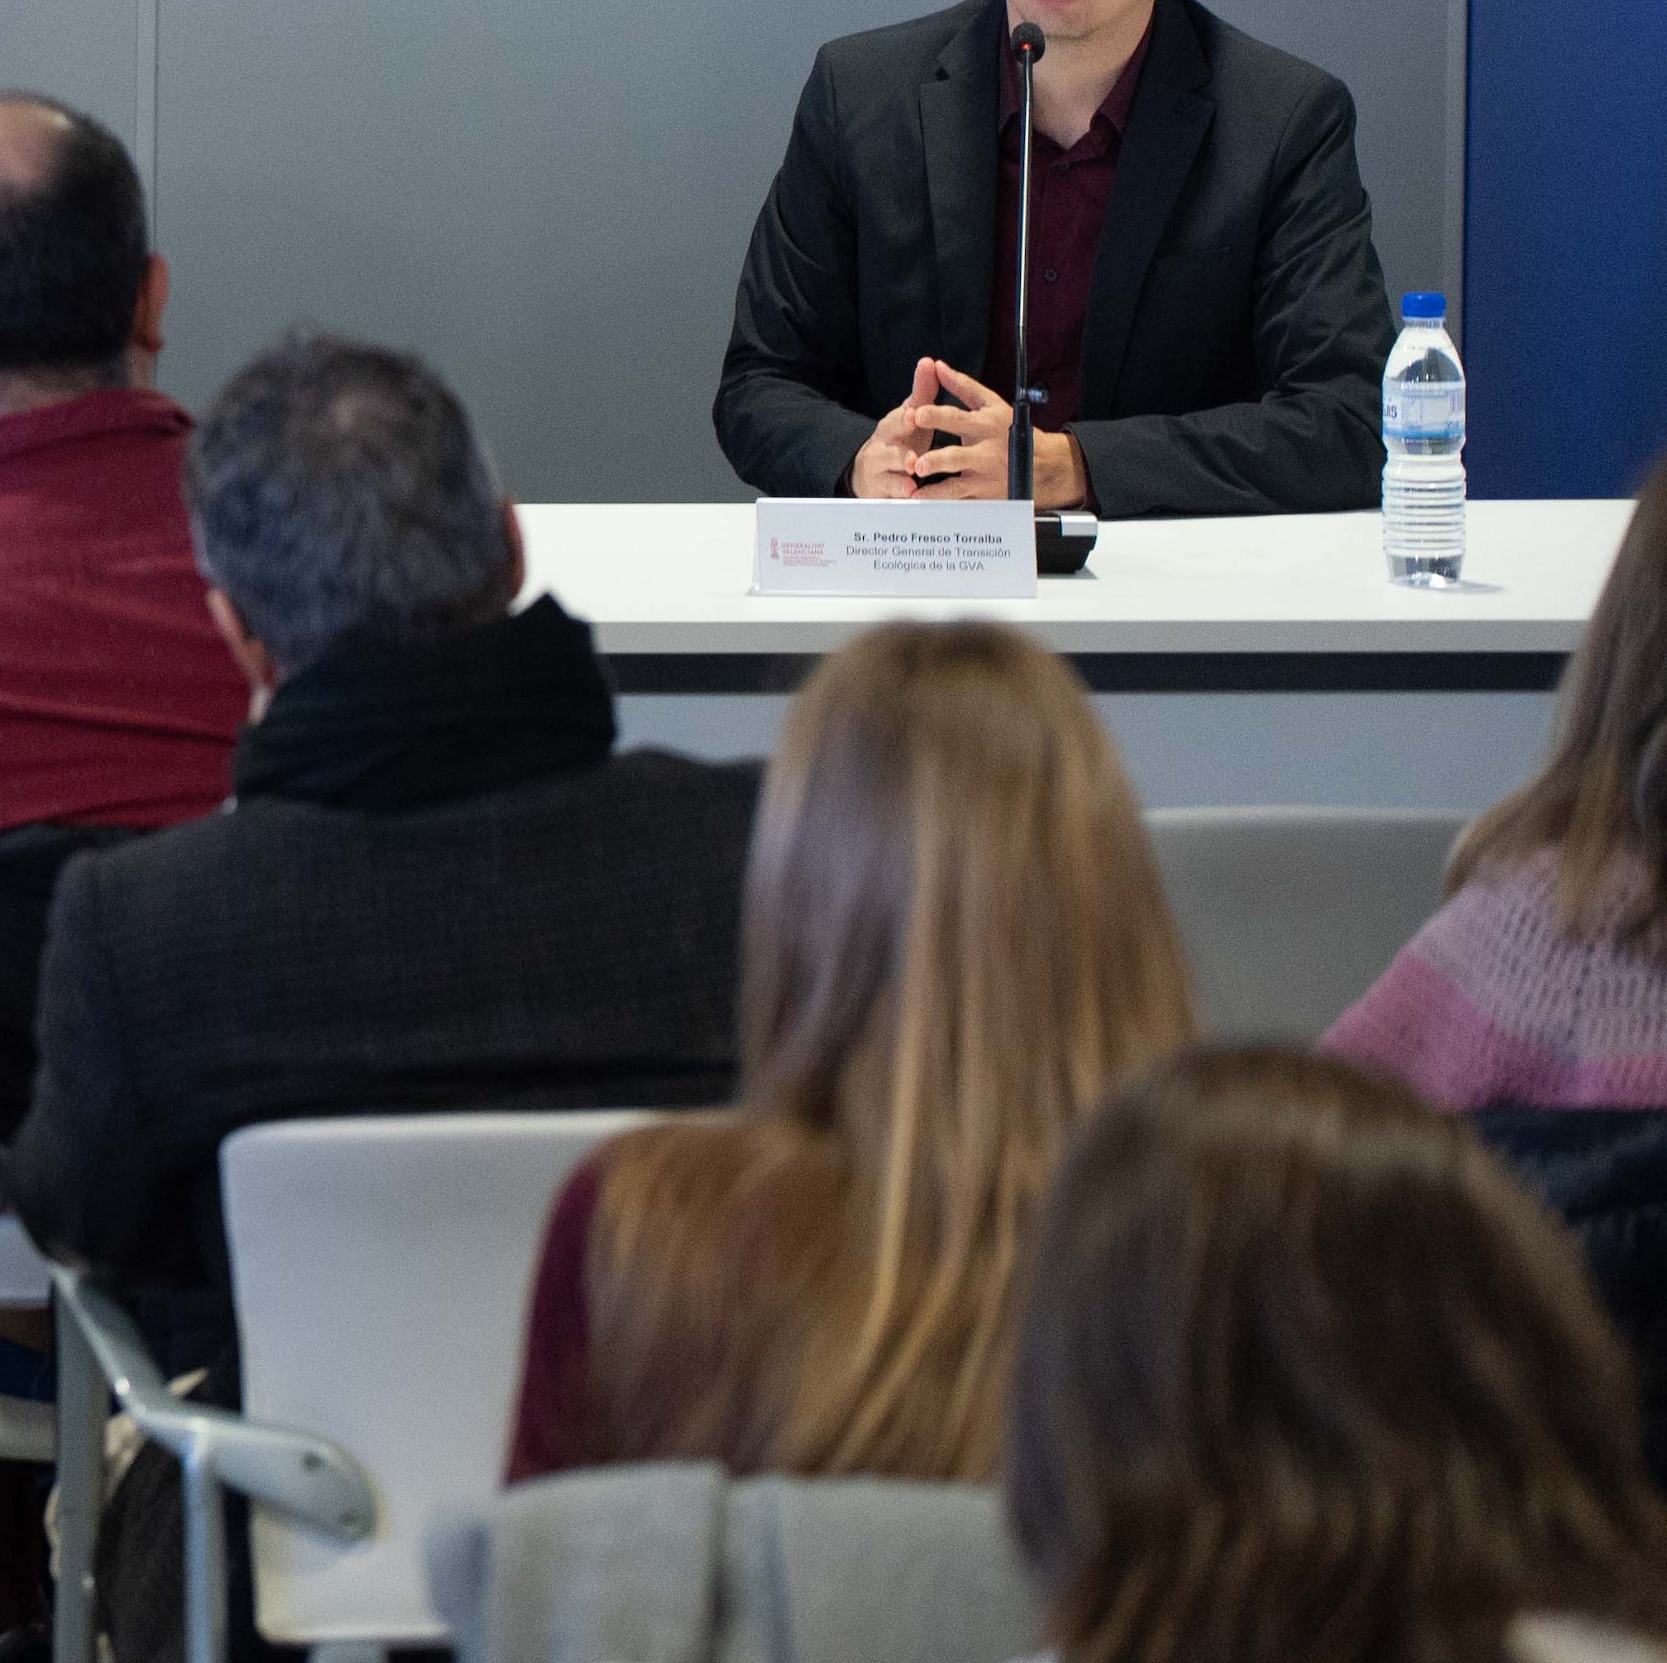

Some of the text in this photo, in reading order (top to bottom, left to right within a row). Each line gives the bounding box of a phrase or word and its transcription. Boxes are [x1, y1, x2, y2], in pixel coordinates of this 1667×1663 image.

[853, 532, 1003, 544] Sr. Pedro Fresco Torralba
[846, 545, 1011, 558] Director General de Transición
[873, 559, 985, 573] Ecológica de la GVA
